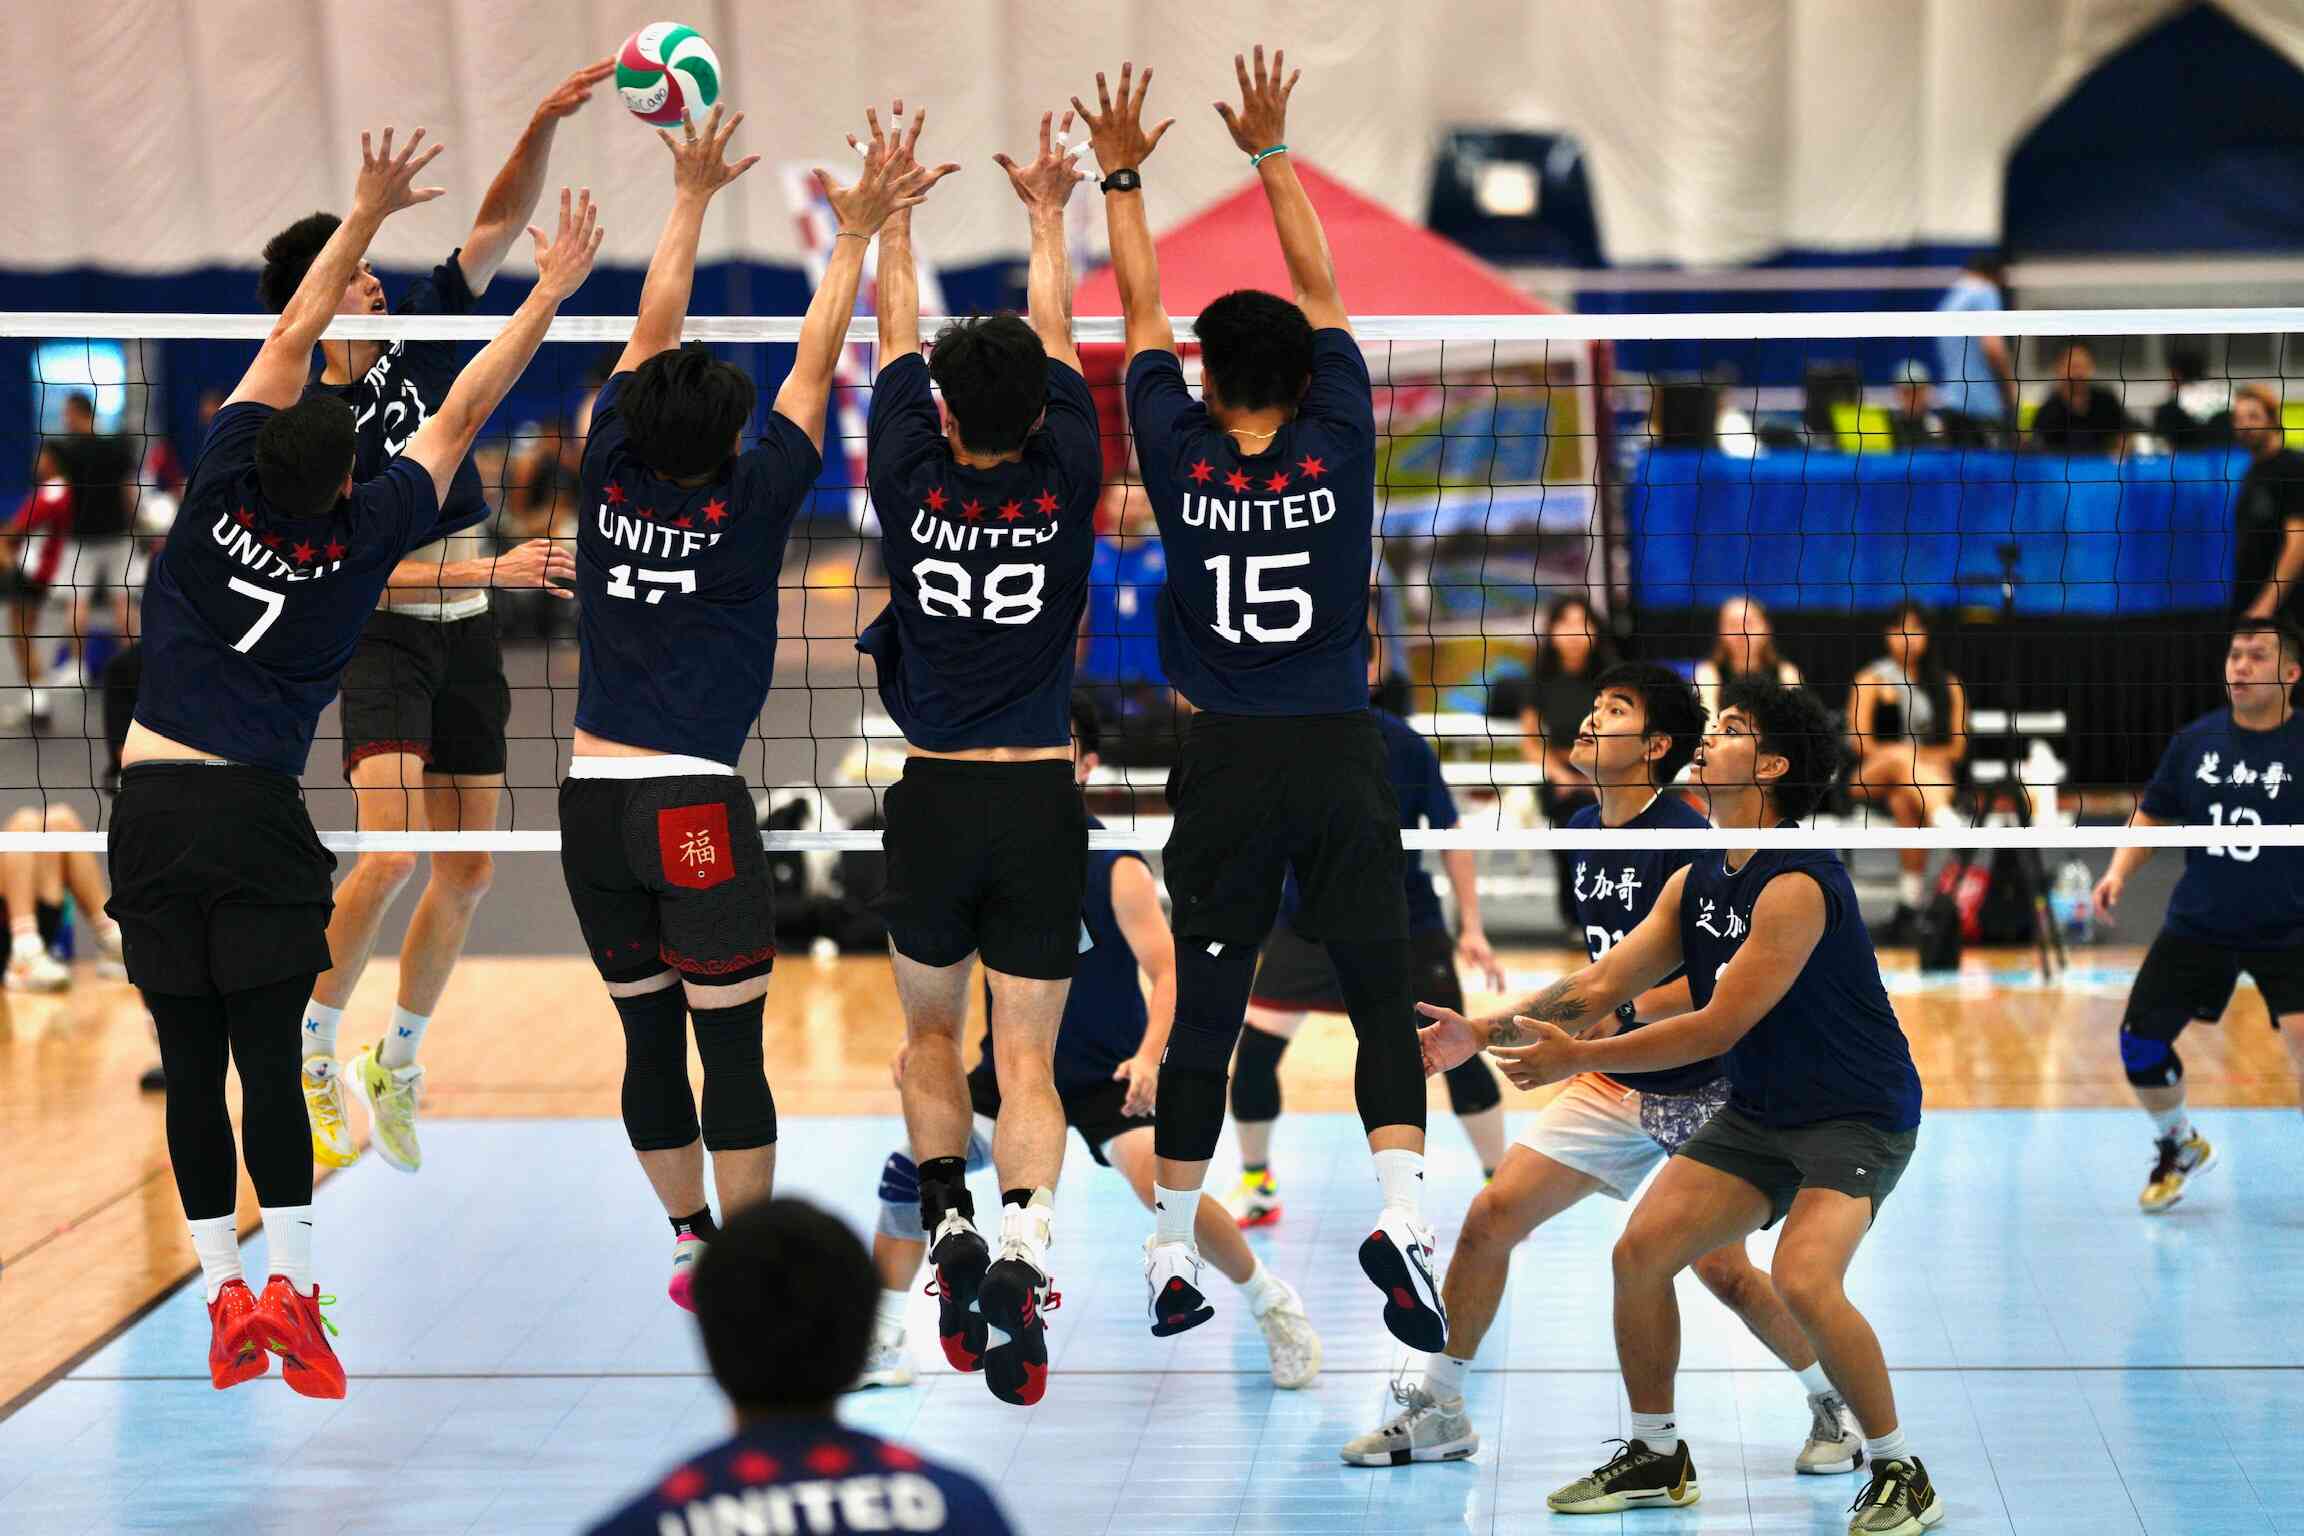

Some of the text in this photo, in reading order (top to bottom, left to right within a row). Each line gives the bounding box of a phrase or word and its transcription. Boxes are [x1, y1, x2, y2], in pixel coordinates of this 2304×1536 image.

[911, 508, 1060, 551] UNITED
[1181, 487, 1337, 532] UNITED
[606, 564, 697, 605] 17
[911, 557, 1046, 625] 88
[1204, 551, 1314, 644] 15
[227, 575, 286, 654] 7
[679, 829, 717, 867] 福
[1695, 897, 1749, 939] 芝加
